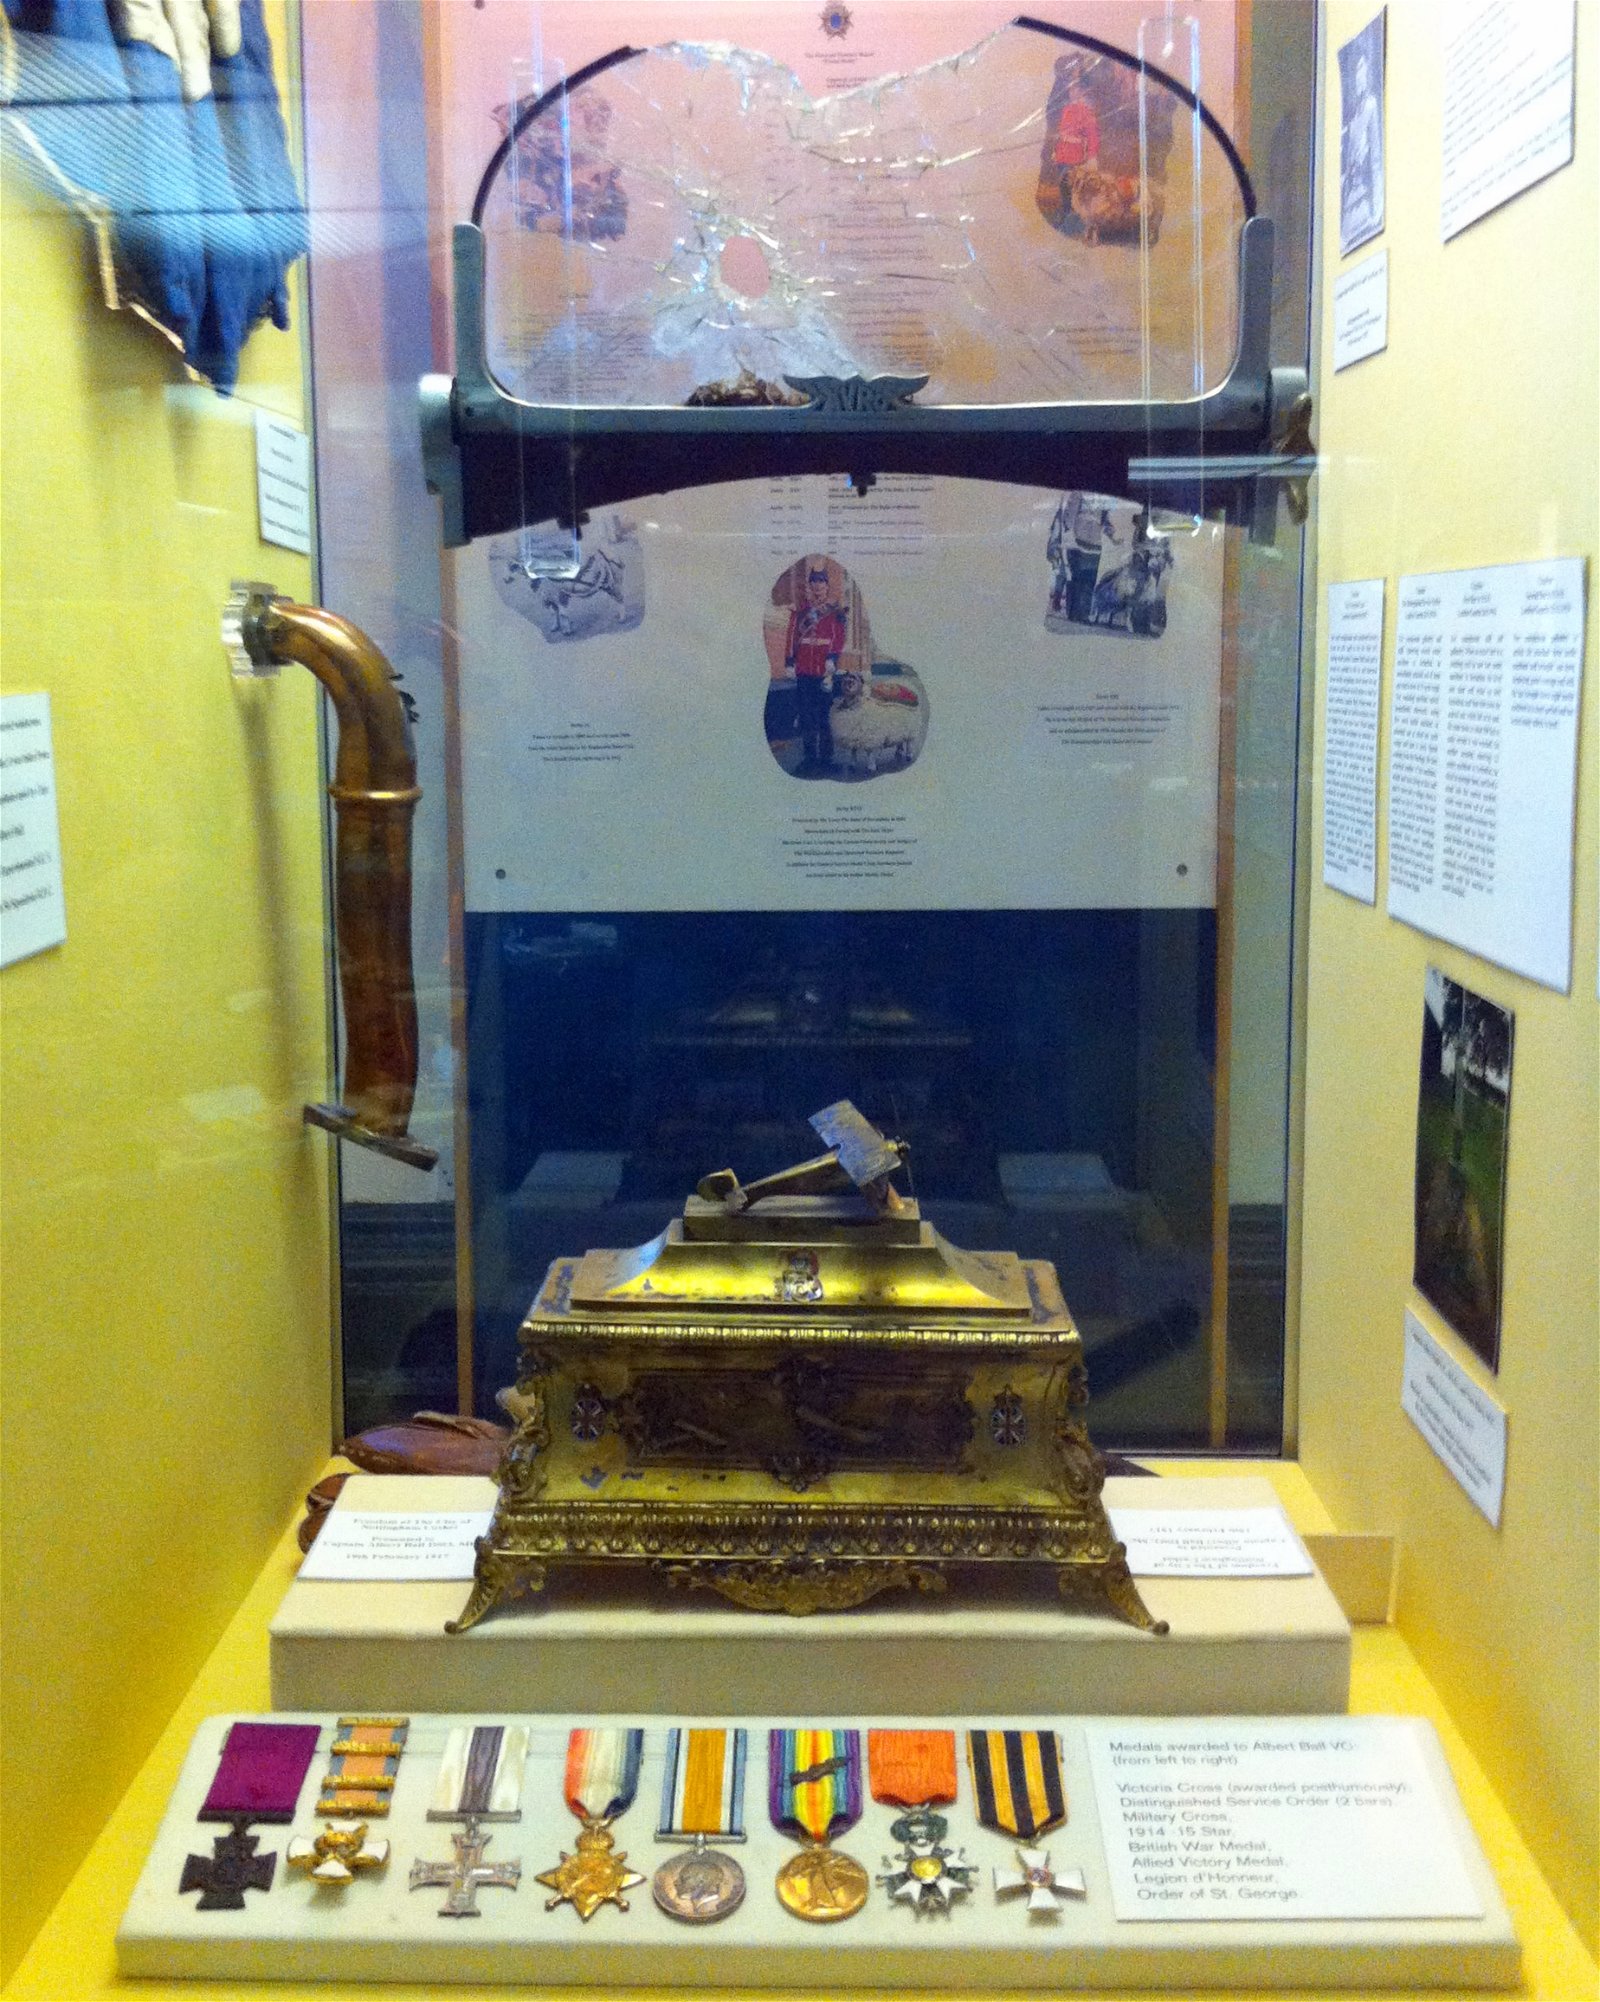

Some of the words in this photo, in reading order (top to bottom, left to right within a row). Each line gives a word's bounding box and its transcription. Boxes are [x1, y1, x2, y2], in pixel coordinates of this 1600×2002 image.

[1110, 1742, 1162, 1752] Medals
[1167, 1742, 1230, 1752] awarded
[1234, 1742, 1248, 1752] to
[1253, 1741, 1295, 1752] Albert
[1299, 1741, 1326, 1752] Ball
[1112, 1755, 1152, 1766] (from
[1156, 1755, 1178, 1766] left
[1182, 1755, 1196, 1765] to
[1200, 1755, 1238, 1767] right)
[1117, 1783, 1172, 1793] Victoria
[1178, 1783, 1222, 1793] Cross
[1227, 1782, 1296, 1794] (awarded
[1120, 1797, 1222, 1809] Distinguished
[1227, 1797, 1281, 1807] Service
[1286, 1797, 1329, 1807] Order
[1336, 1796, 1350, 1808] (2
[1123, 1812, 1175, 1824] Military
[1129, 1842, 1178, 1852] British
[1181, 1842, 1212, 1852] War
[1132, 1856, 1174, 1867] Allied
[1178, 1856, 1231, 1869] Victory
[1134, 1873, 1187, 1884] Legion
[1137, 1889, 1185, 1900] Order
[1190, 1888, 1205, 1899] of
